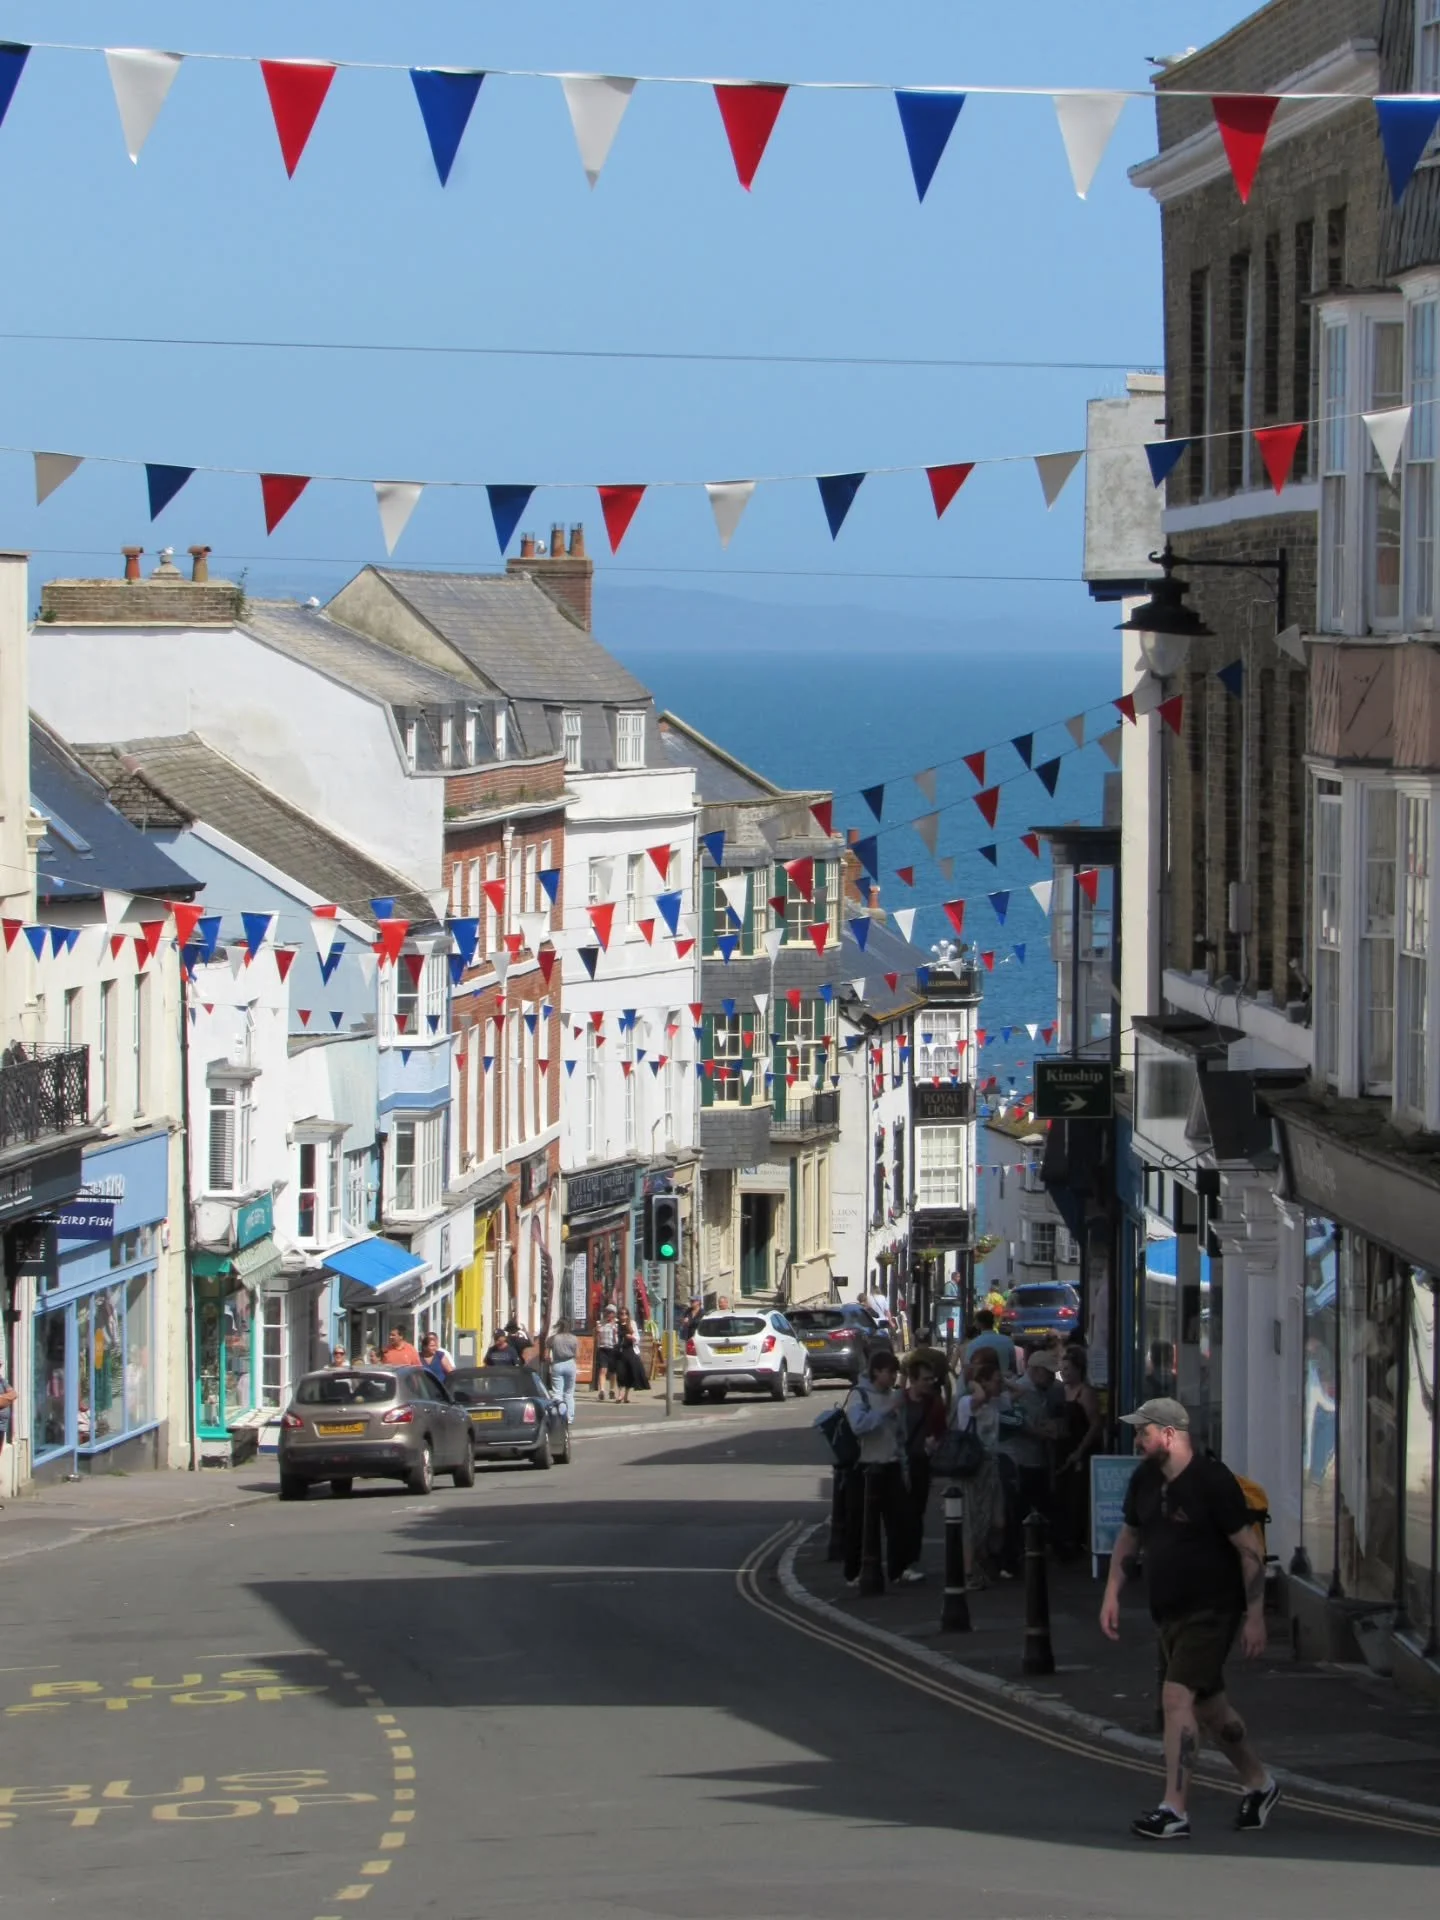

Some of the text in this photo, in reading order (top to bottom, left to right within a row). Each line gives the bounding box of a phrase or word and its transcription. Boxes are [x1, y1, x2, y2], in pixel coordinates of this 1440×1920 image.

[1046, 1069, 1104, 1084] Kinship
[924, 1093, 960, 1104] ROYAL
[928, 1104, 955, 1116] LION
[88, 1215, 113, 1228] FISH
[31, 1669, 284, 1698] BUS
[4, 1685, 329, 1716] STOP
[0, 1769, 329, 1806] BUS
